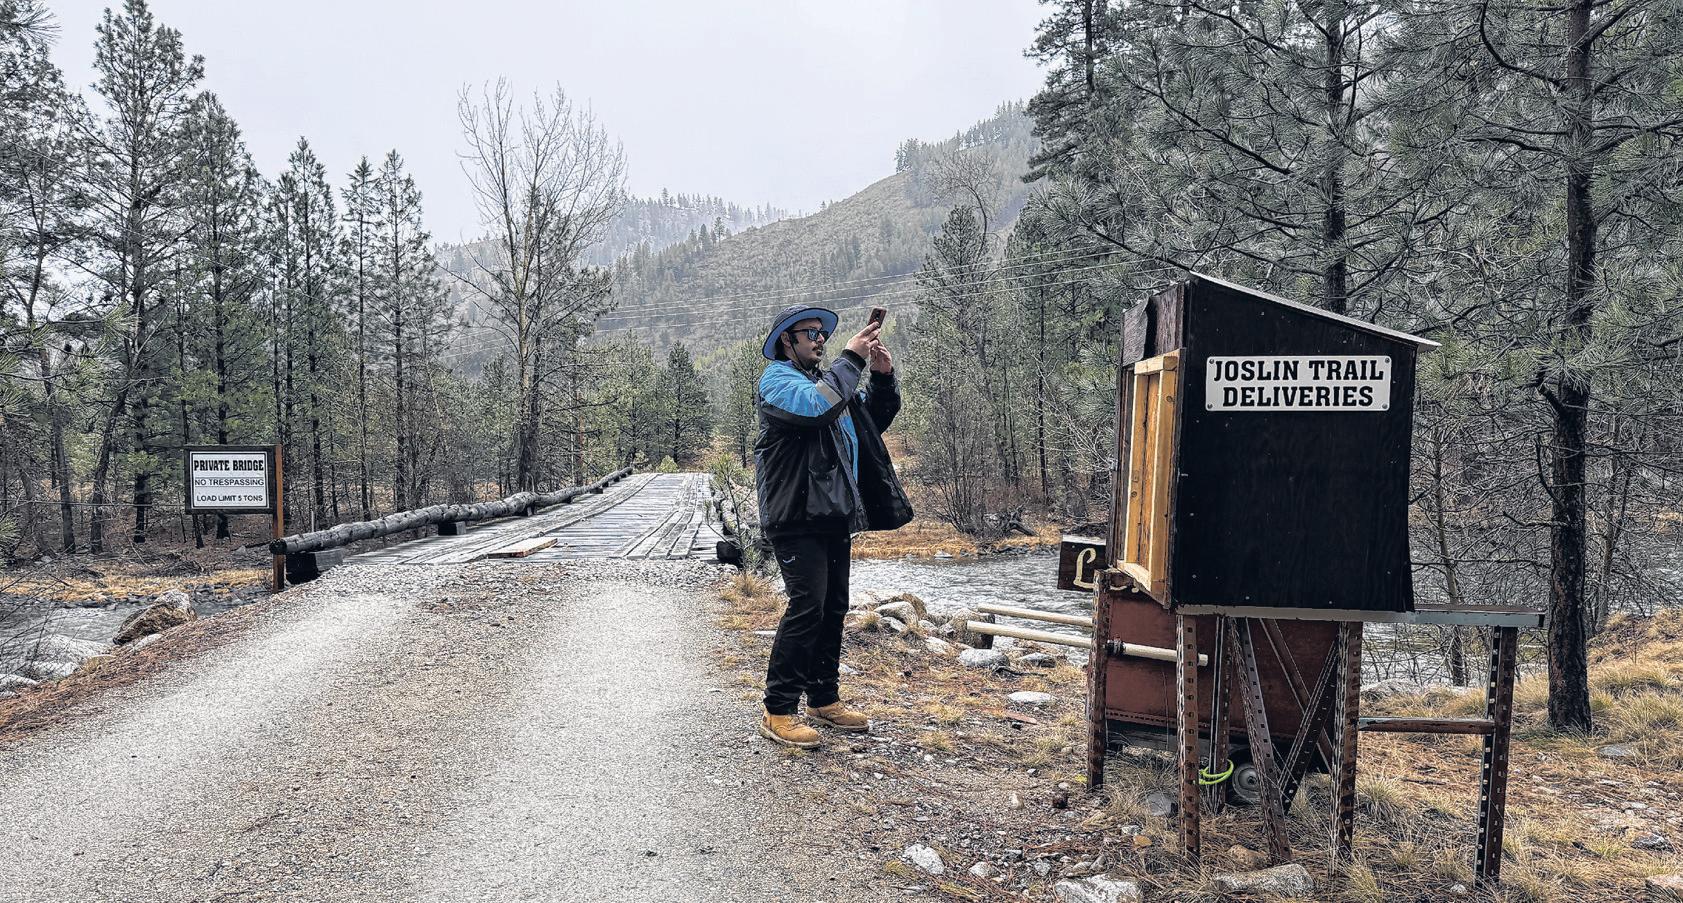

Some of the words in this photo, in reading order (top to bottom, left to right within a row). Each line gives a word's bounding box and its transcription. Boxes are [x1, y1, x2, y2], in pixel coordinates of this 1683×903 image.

[1214, 360, 1299, 382] JOSLIN
[1308, 360, 1384, 381] TRAIL
[1223, 386, 1373, 407] DELIVERIES
[194, 460, 230, 471] PRIVATE
[233, 460, 264, 471] BRIDGE
